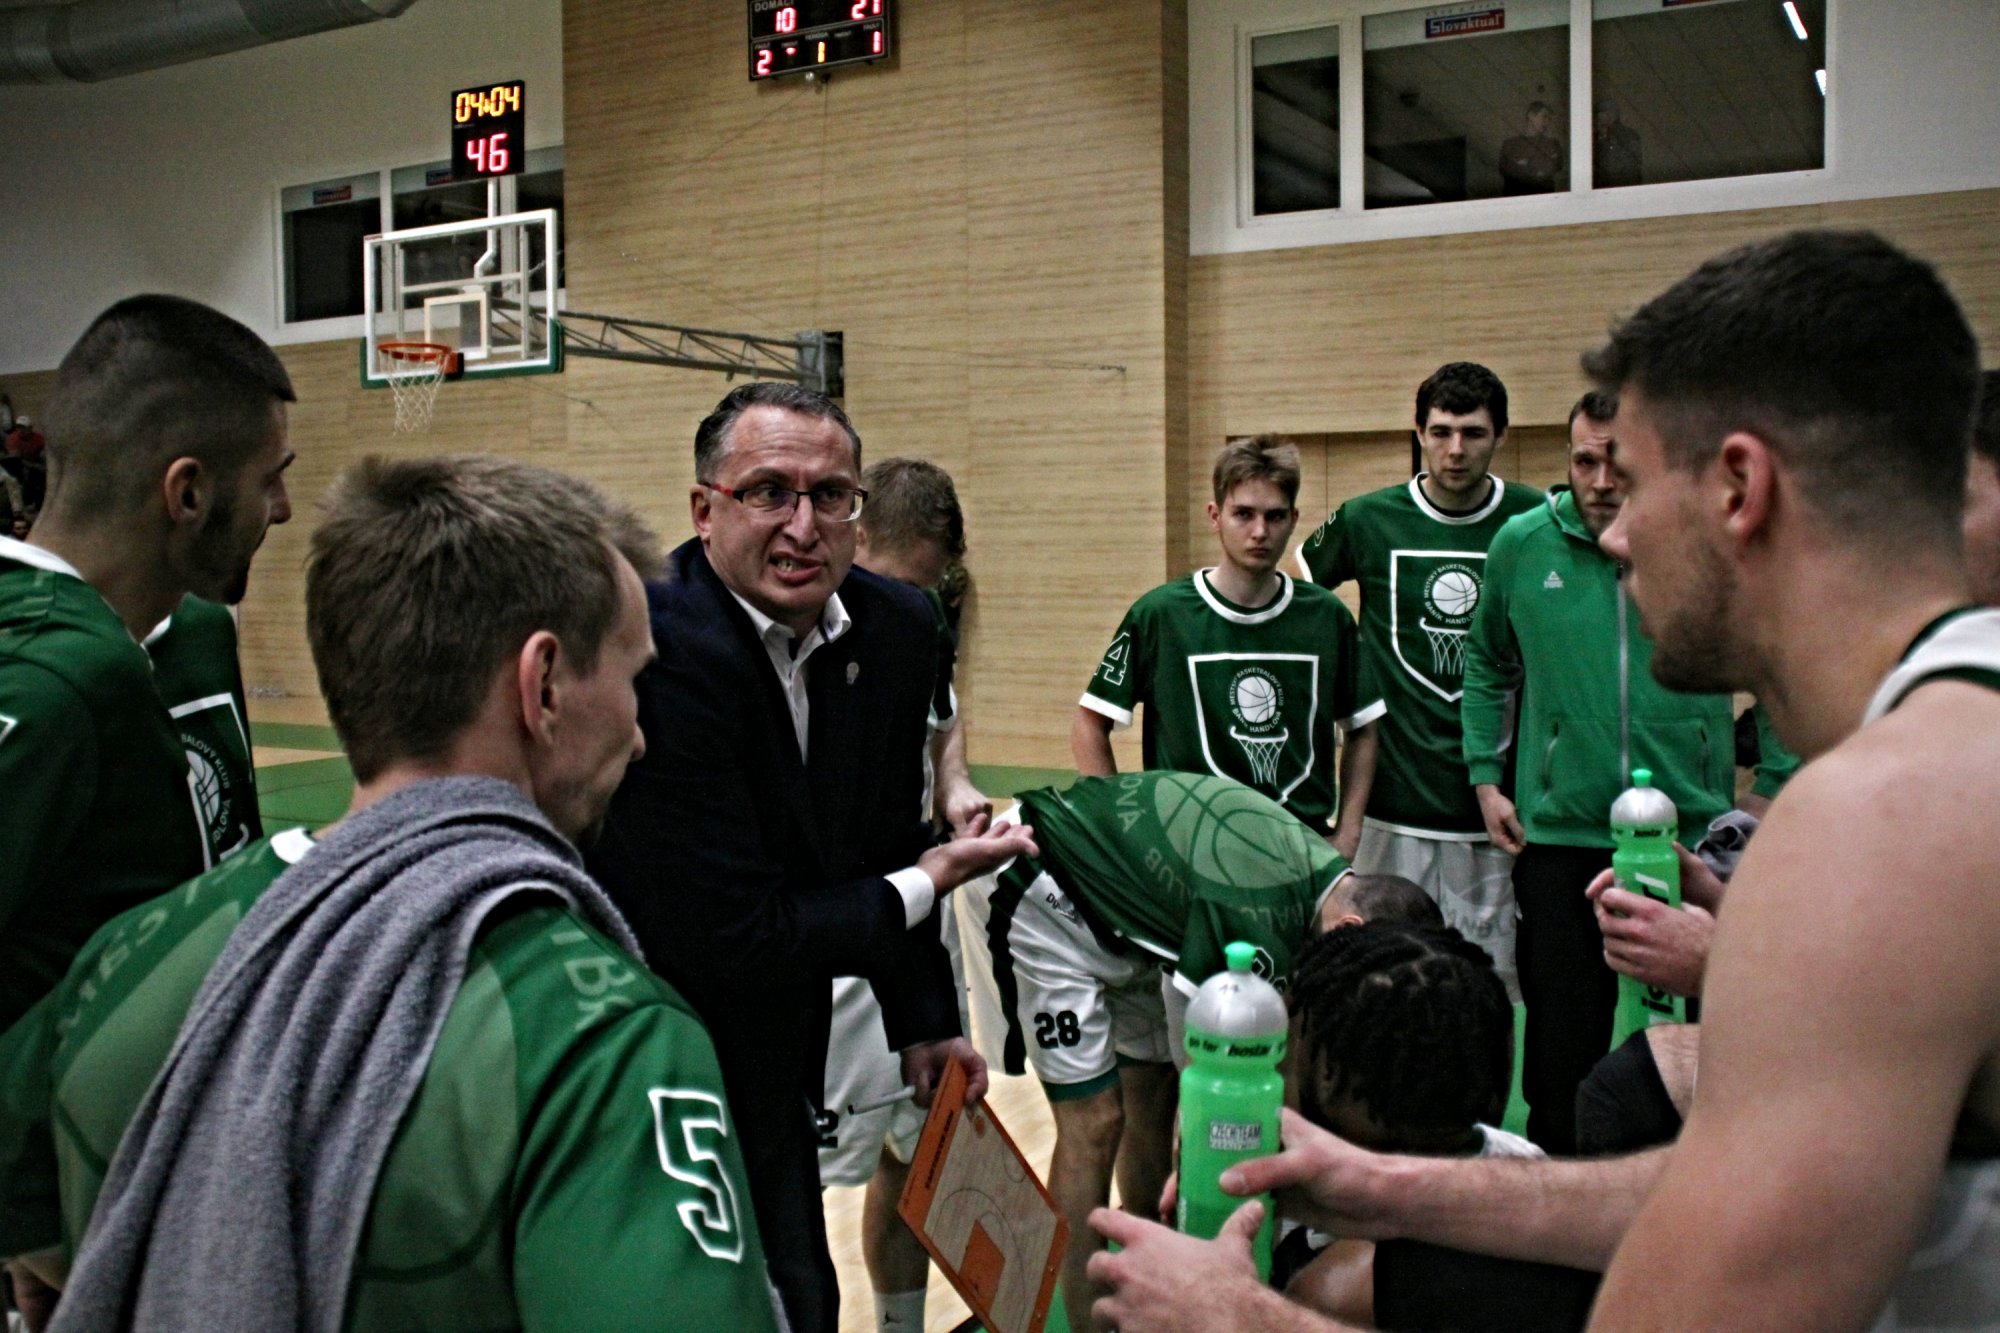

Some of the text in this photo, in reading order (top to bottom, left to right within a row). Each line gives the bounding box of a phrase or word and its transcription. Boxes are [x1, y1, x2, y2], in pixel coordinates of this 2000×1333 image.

[775, 7, 797, 33] 10
[817, 41, 825, 63] 1
[872, 31, 881, 53] 1
[757, 49, 772, 75] 2
[455, 85, 520, 123] 04:04
[466, 133, 509, 172] 46
[1033, 1010, 1081, 1049] 28
[647, 1088, 744, 1264] 5
